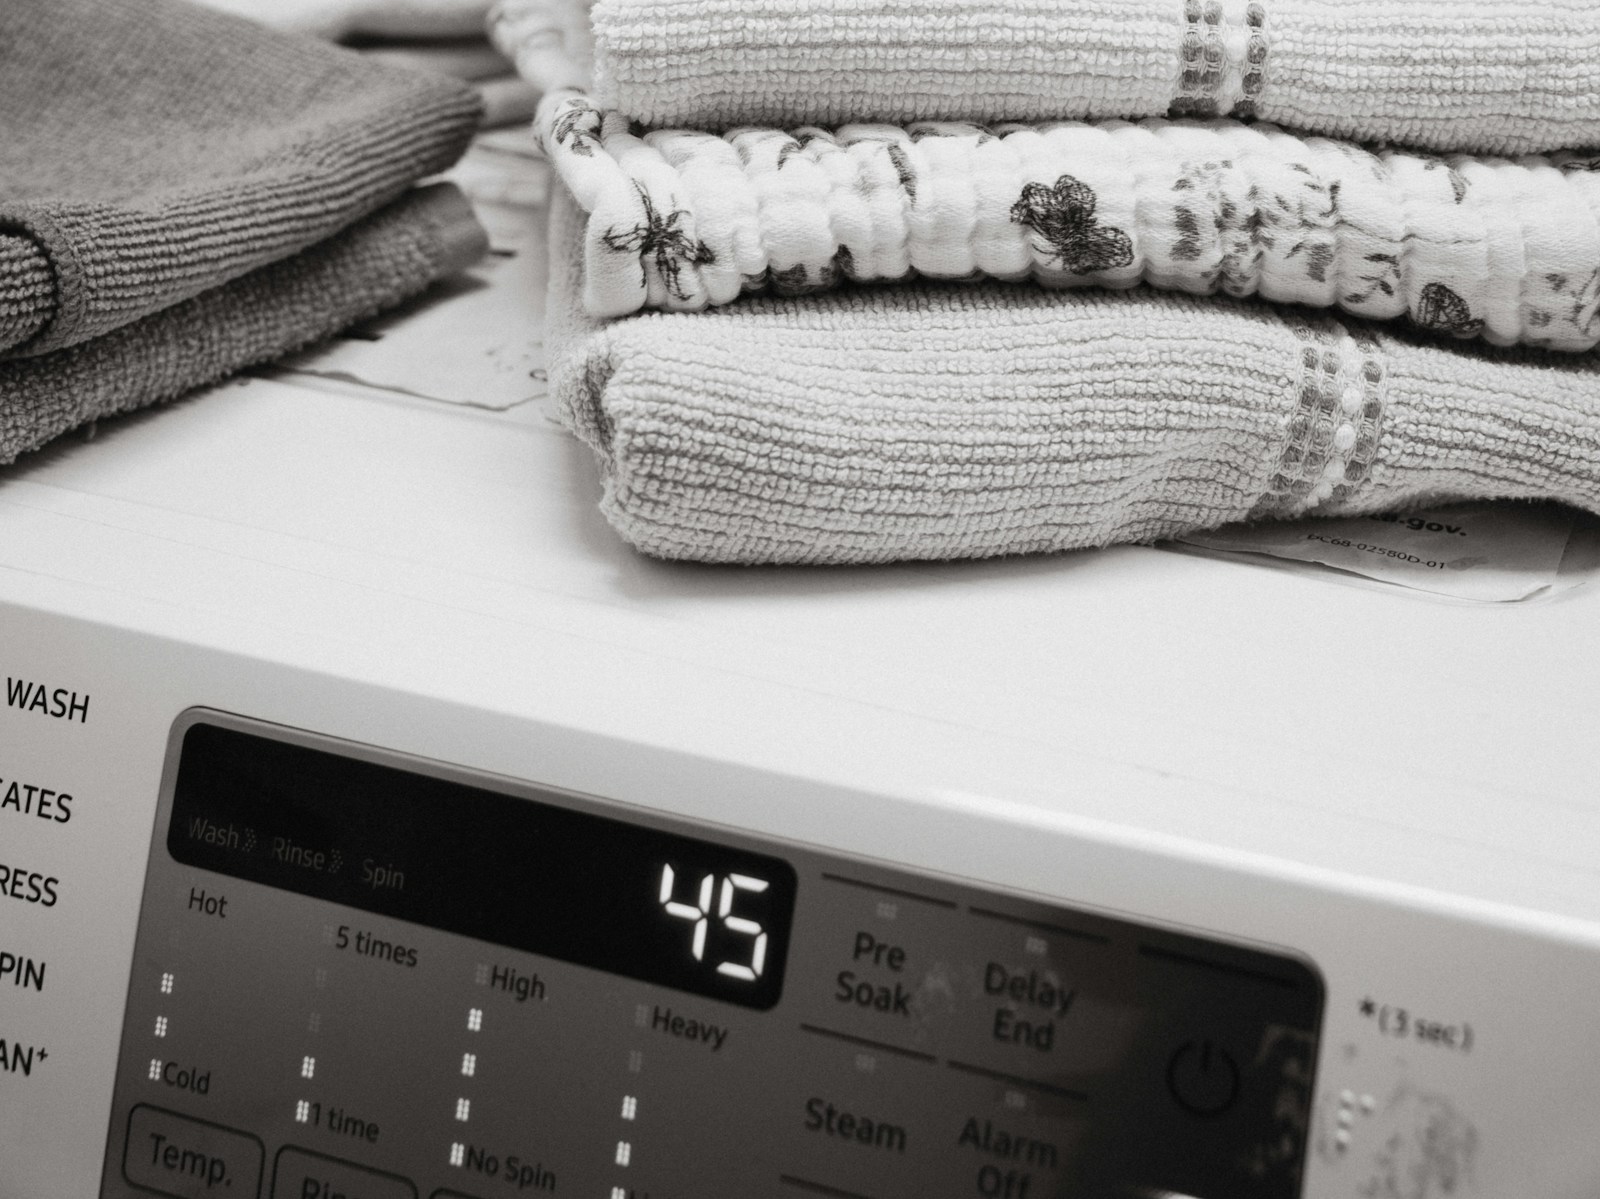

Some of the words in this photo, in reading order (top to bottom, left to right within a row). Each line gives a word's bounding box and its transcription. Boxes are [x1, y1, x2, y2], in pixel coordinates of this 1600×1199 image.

[1306, 533, 1445, 569] DC68-02580D-01
[7, 677, 90, 723] WASH
[0, 777, 73, 823] ATES
[187, 816, 239, 849] Wash
[271, 836, 326, 871] Rinse
[362, 858, 405, 889] Spin
[188, 887, 228, 919] Hot
[659, 862, 769, 982] 45
[335, 926, 350, 950] 5
[355, 931, 418, 968] times
[853, 930, 906, 972] Pre
[0, 953, 46, 992] PIN
[490, 965, 546, 1002] High
[835, 970, 911, 1017] Soak
[984, 961, 1075, 1019] Delay
[652, 1005, 728, 1052] Heavy
[993, 1007, 1056, 1051] End
[163, 1061, 211, 1095] Cold
[311, 1102, 321, 1125] 1
[327, 1107, 380, 1144] time
[804, 1097, 908, 1152] Steam
[957, 1115, 1058, 1167] Alarm
[150, 1132, 233, 1188] Temp.
[466, 1145, 499, 1177] No
[503, 1155, 557, 1191] Spin
[977, 1164, 1033, 1199] Off
